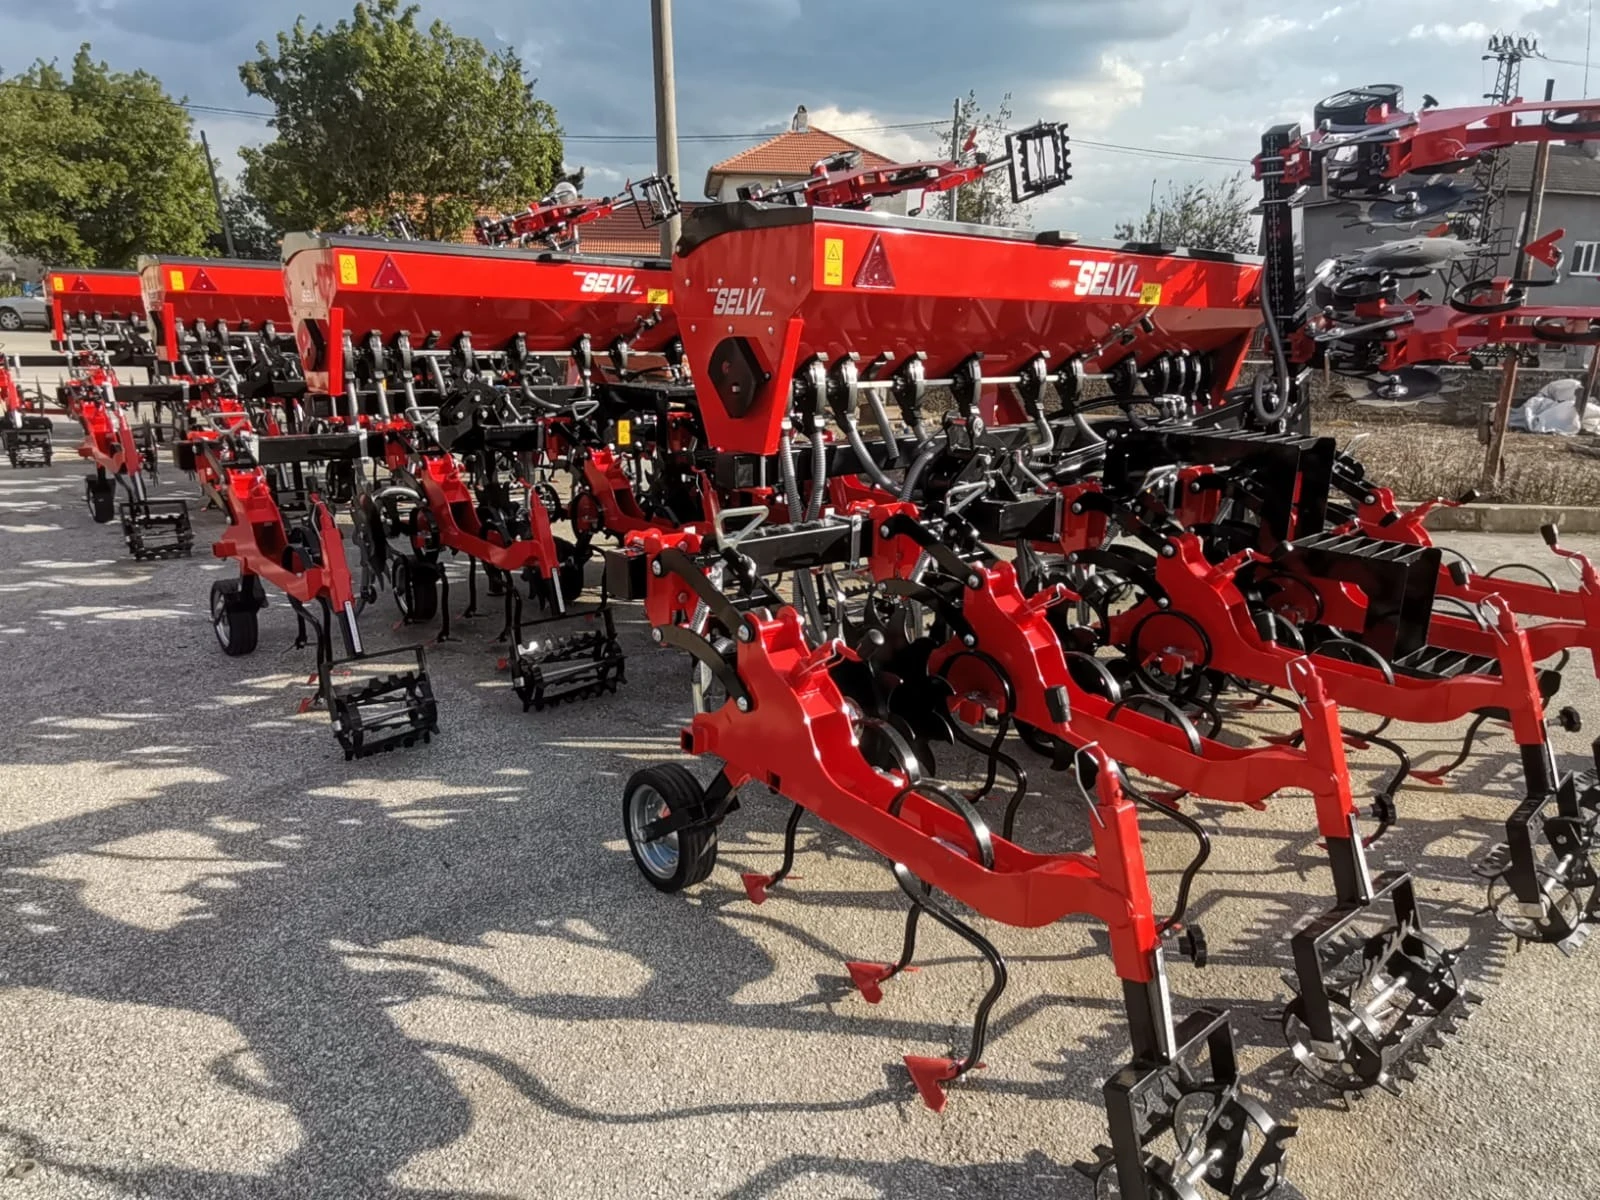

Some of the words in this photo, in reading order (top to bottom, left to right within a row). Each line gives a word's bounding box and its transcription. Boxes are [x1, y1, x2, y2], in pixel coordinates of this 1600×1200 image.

[580, 272, 635, 293] SELVI
[1074, 261, 1138, 297] SELVI
[713, 288, 766, 315] SELVI
